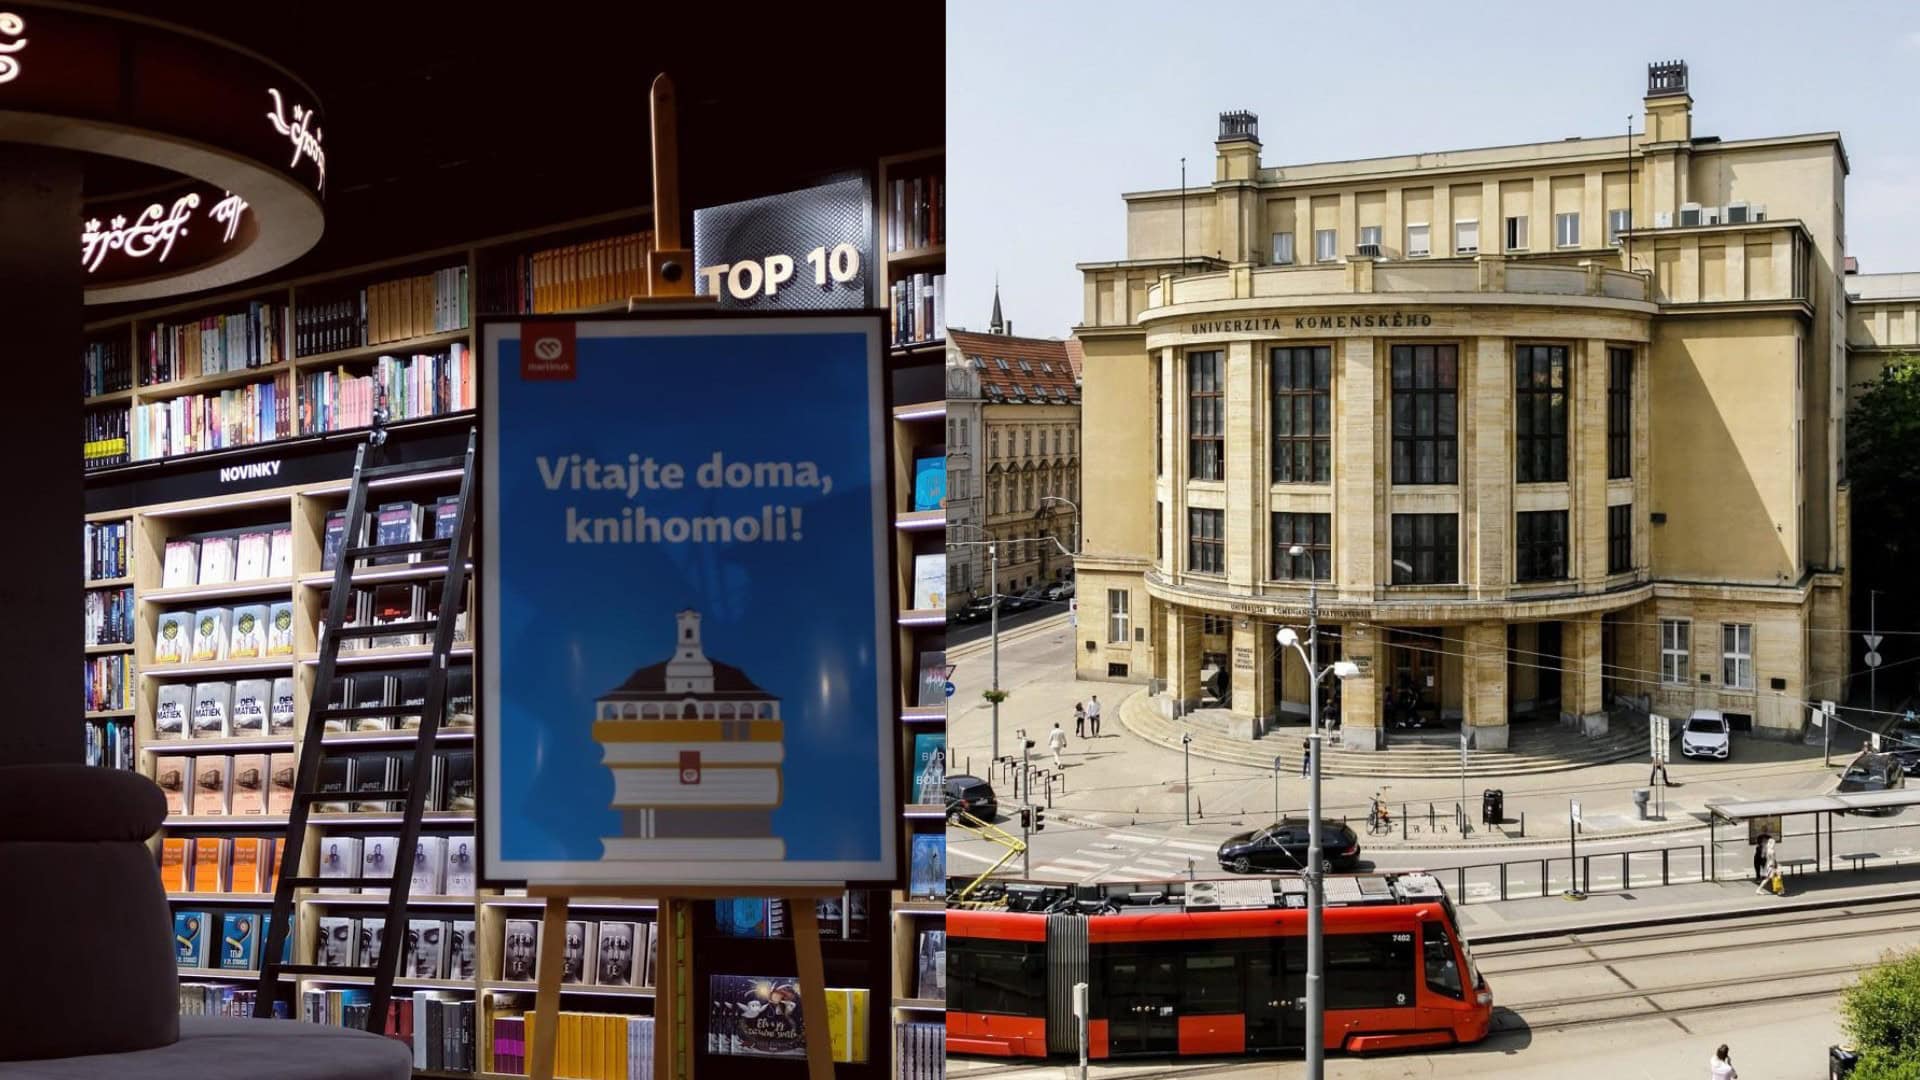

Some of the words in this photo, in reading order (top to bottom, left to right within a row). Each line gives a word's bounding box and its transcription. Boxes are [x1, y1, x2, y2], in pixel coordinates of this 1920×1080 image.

[700, 254, 794, 302] TOP
[807, 242, 860, 285] 10
[1191, 318, 1281, 335] UNIVERZITA
[1295, 312, 1432, 330] KOMENSKÉHO
[220, 460, 281, 482] NOVINKY
[536, 453, 685, 499] Vitajte
[696, 451, 833, 495] doma,
[566, 504, 804, 543] knihomoli!
